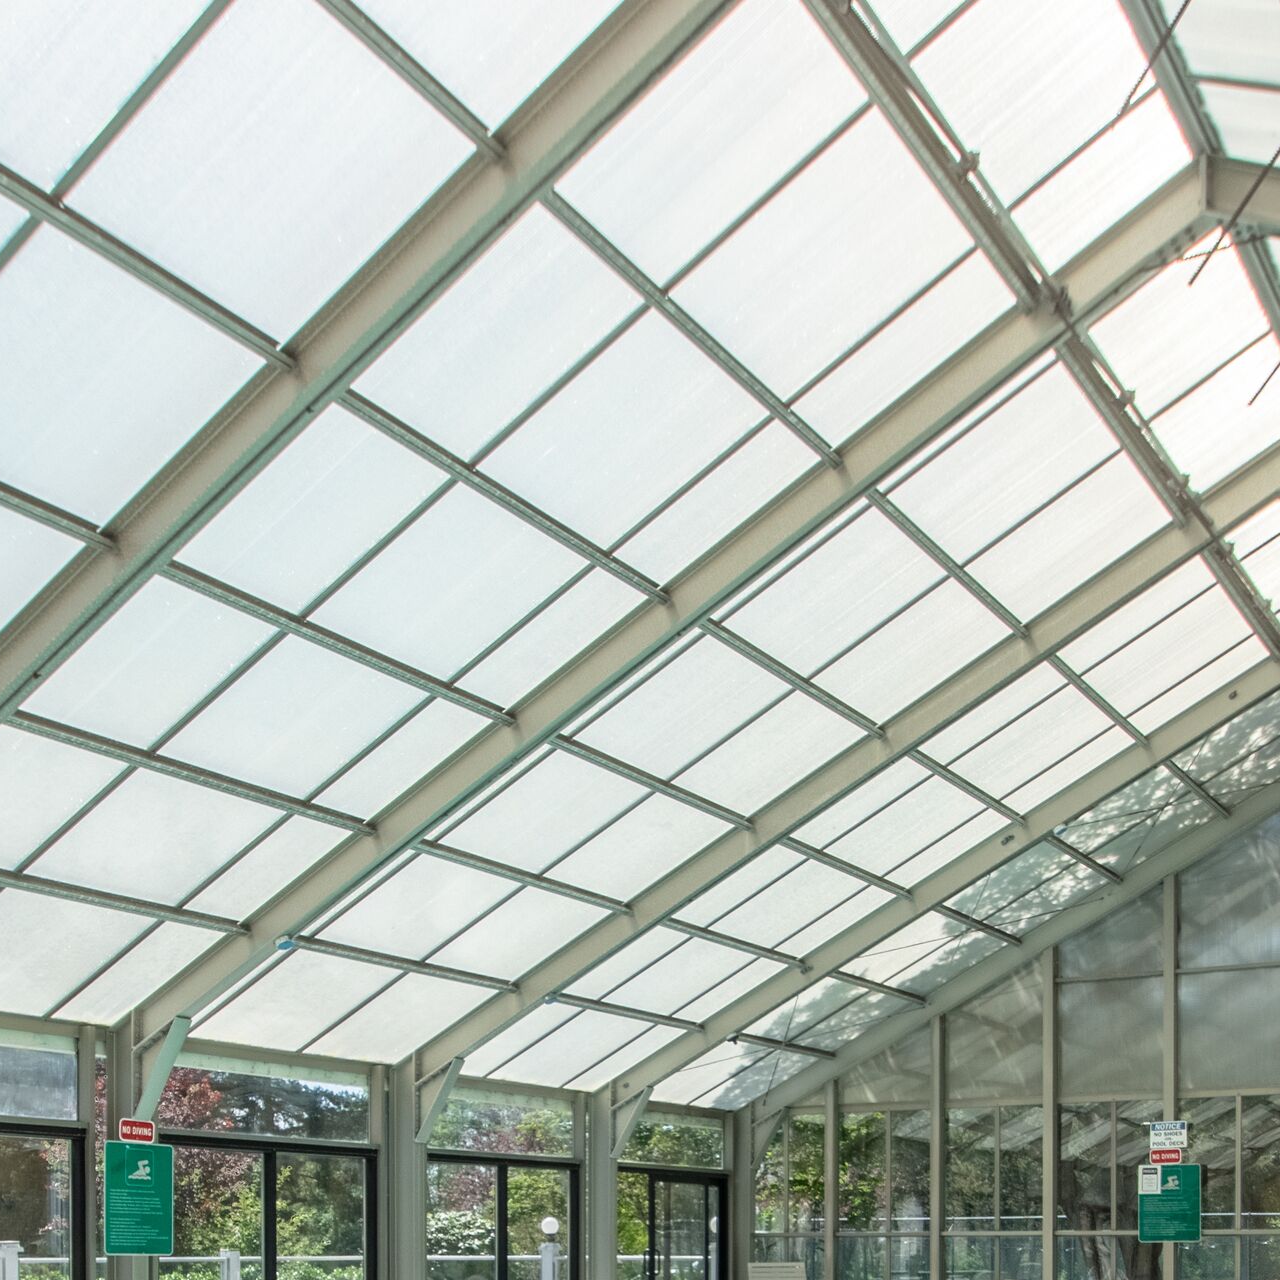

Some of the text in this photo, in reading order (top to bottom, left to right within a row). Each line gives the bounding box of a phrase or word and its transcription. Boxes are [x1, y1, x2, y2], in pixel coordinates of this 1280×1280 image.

[122, 1125, 152, 1137] NO DIVING
[1154, 1122, 1182, 1131] NOTICE
[1161, 1152, 1179, 1160] DIVING
